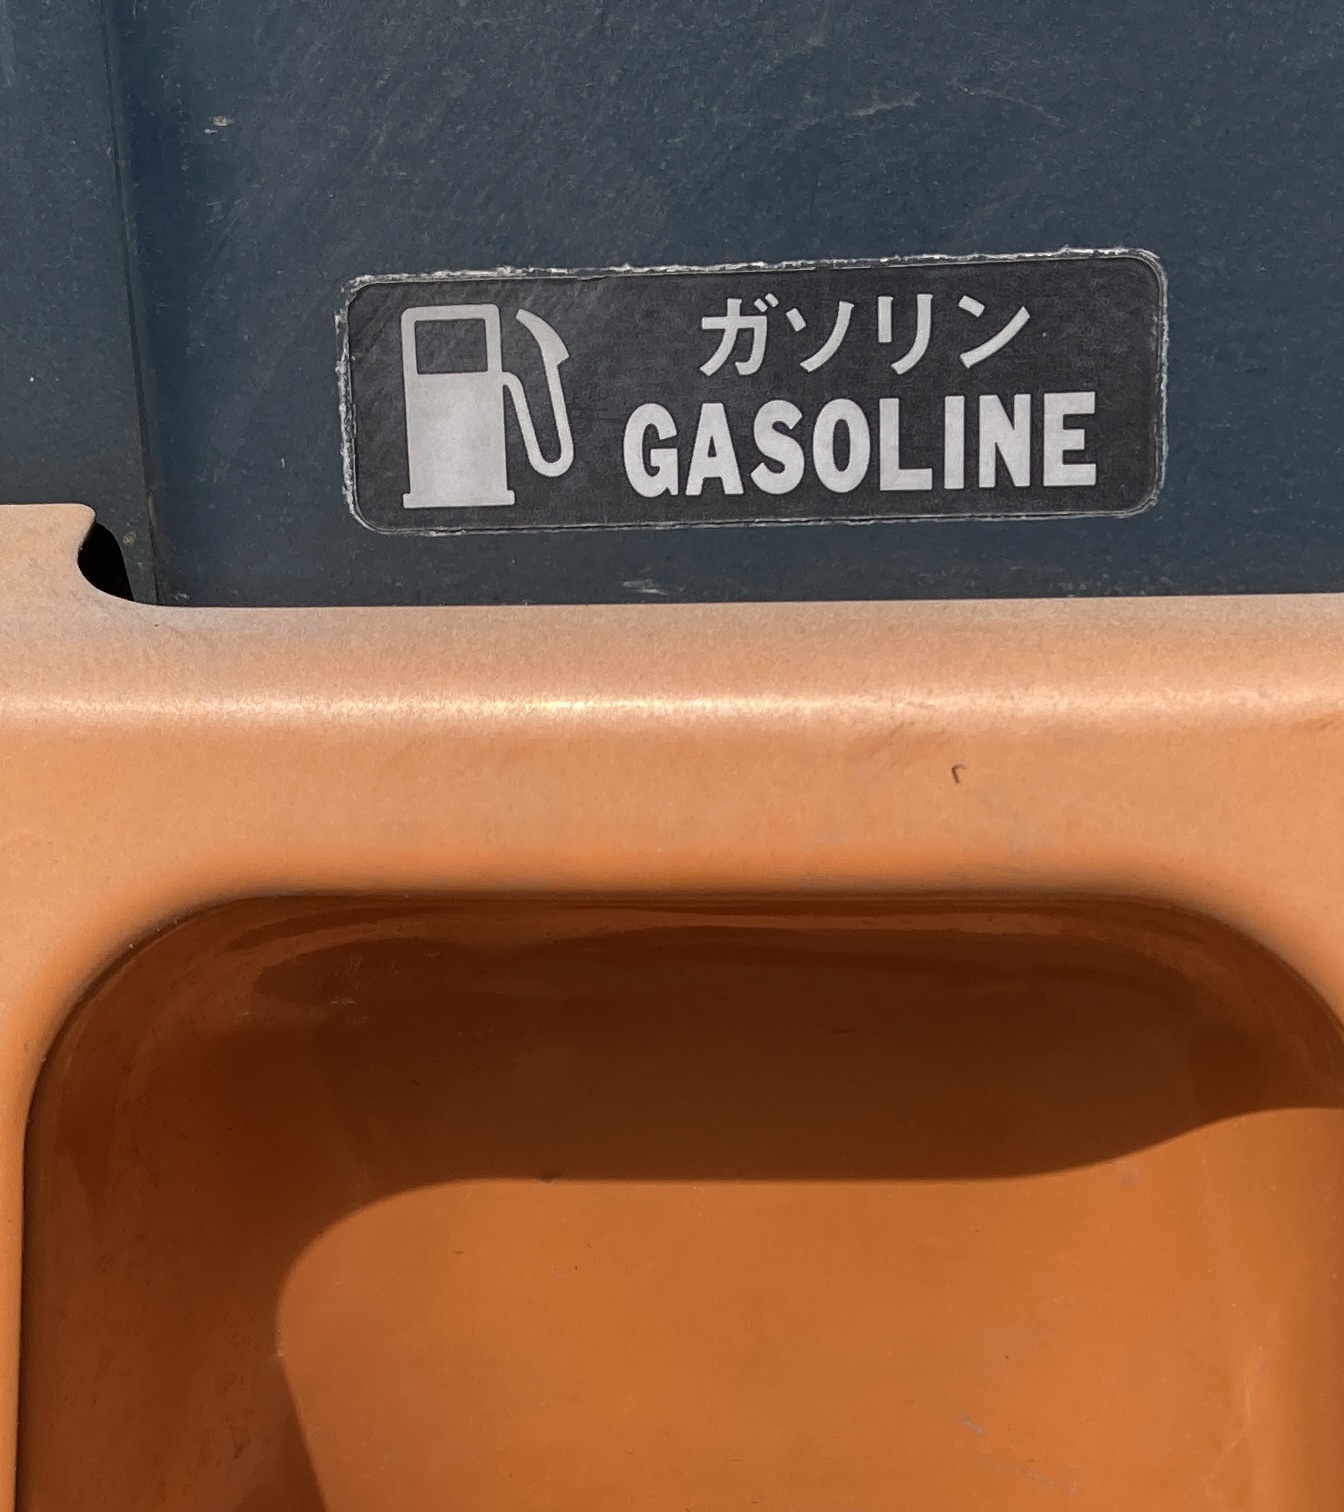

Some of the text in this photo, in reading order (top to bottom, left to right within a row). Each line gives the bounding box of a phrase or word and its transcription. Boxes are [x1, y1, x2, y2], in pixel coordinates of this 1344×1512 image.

[700, 293, 1030, 377] ガソリン
[622, 391, 1098, 499] GASOLINE
